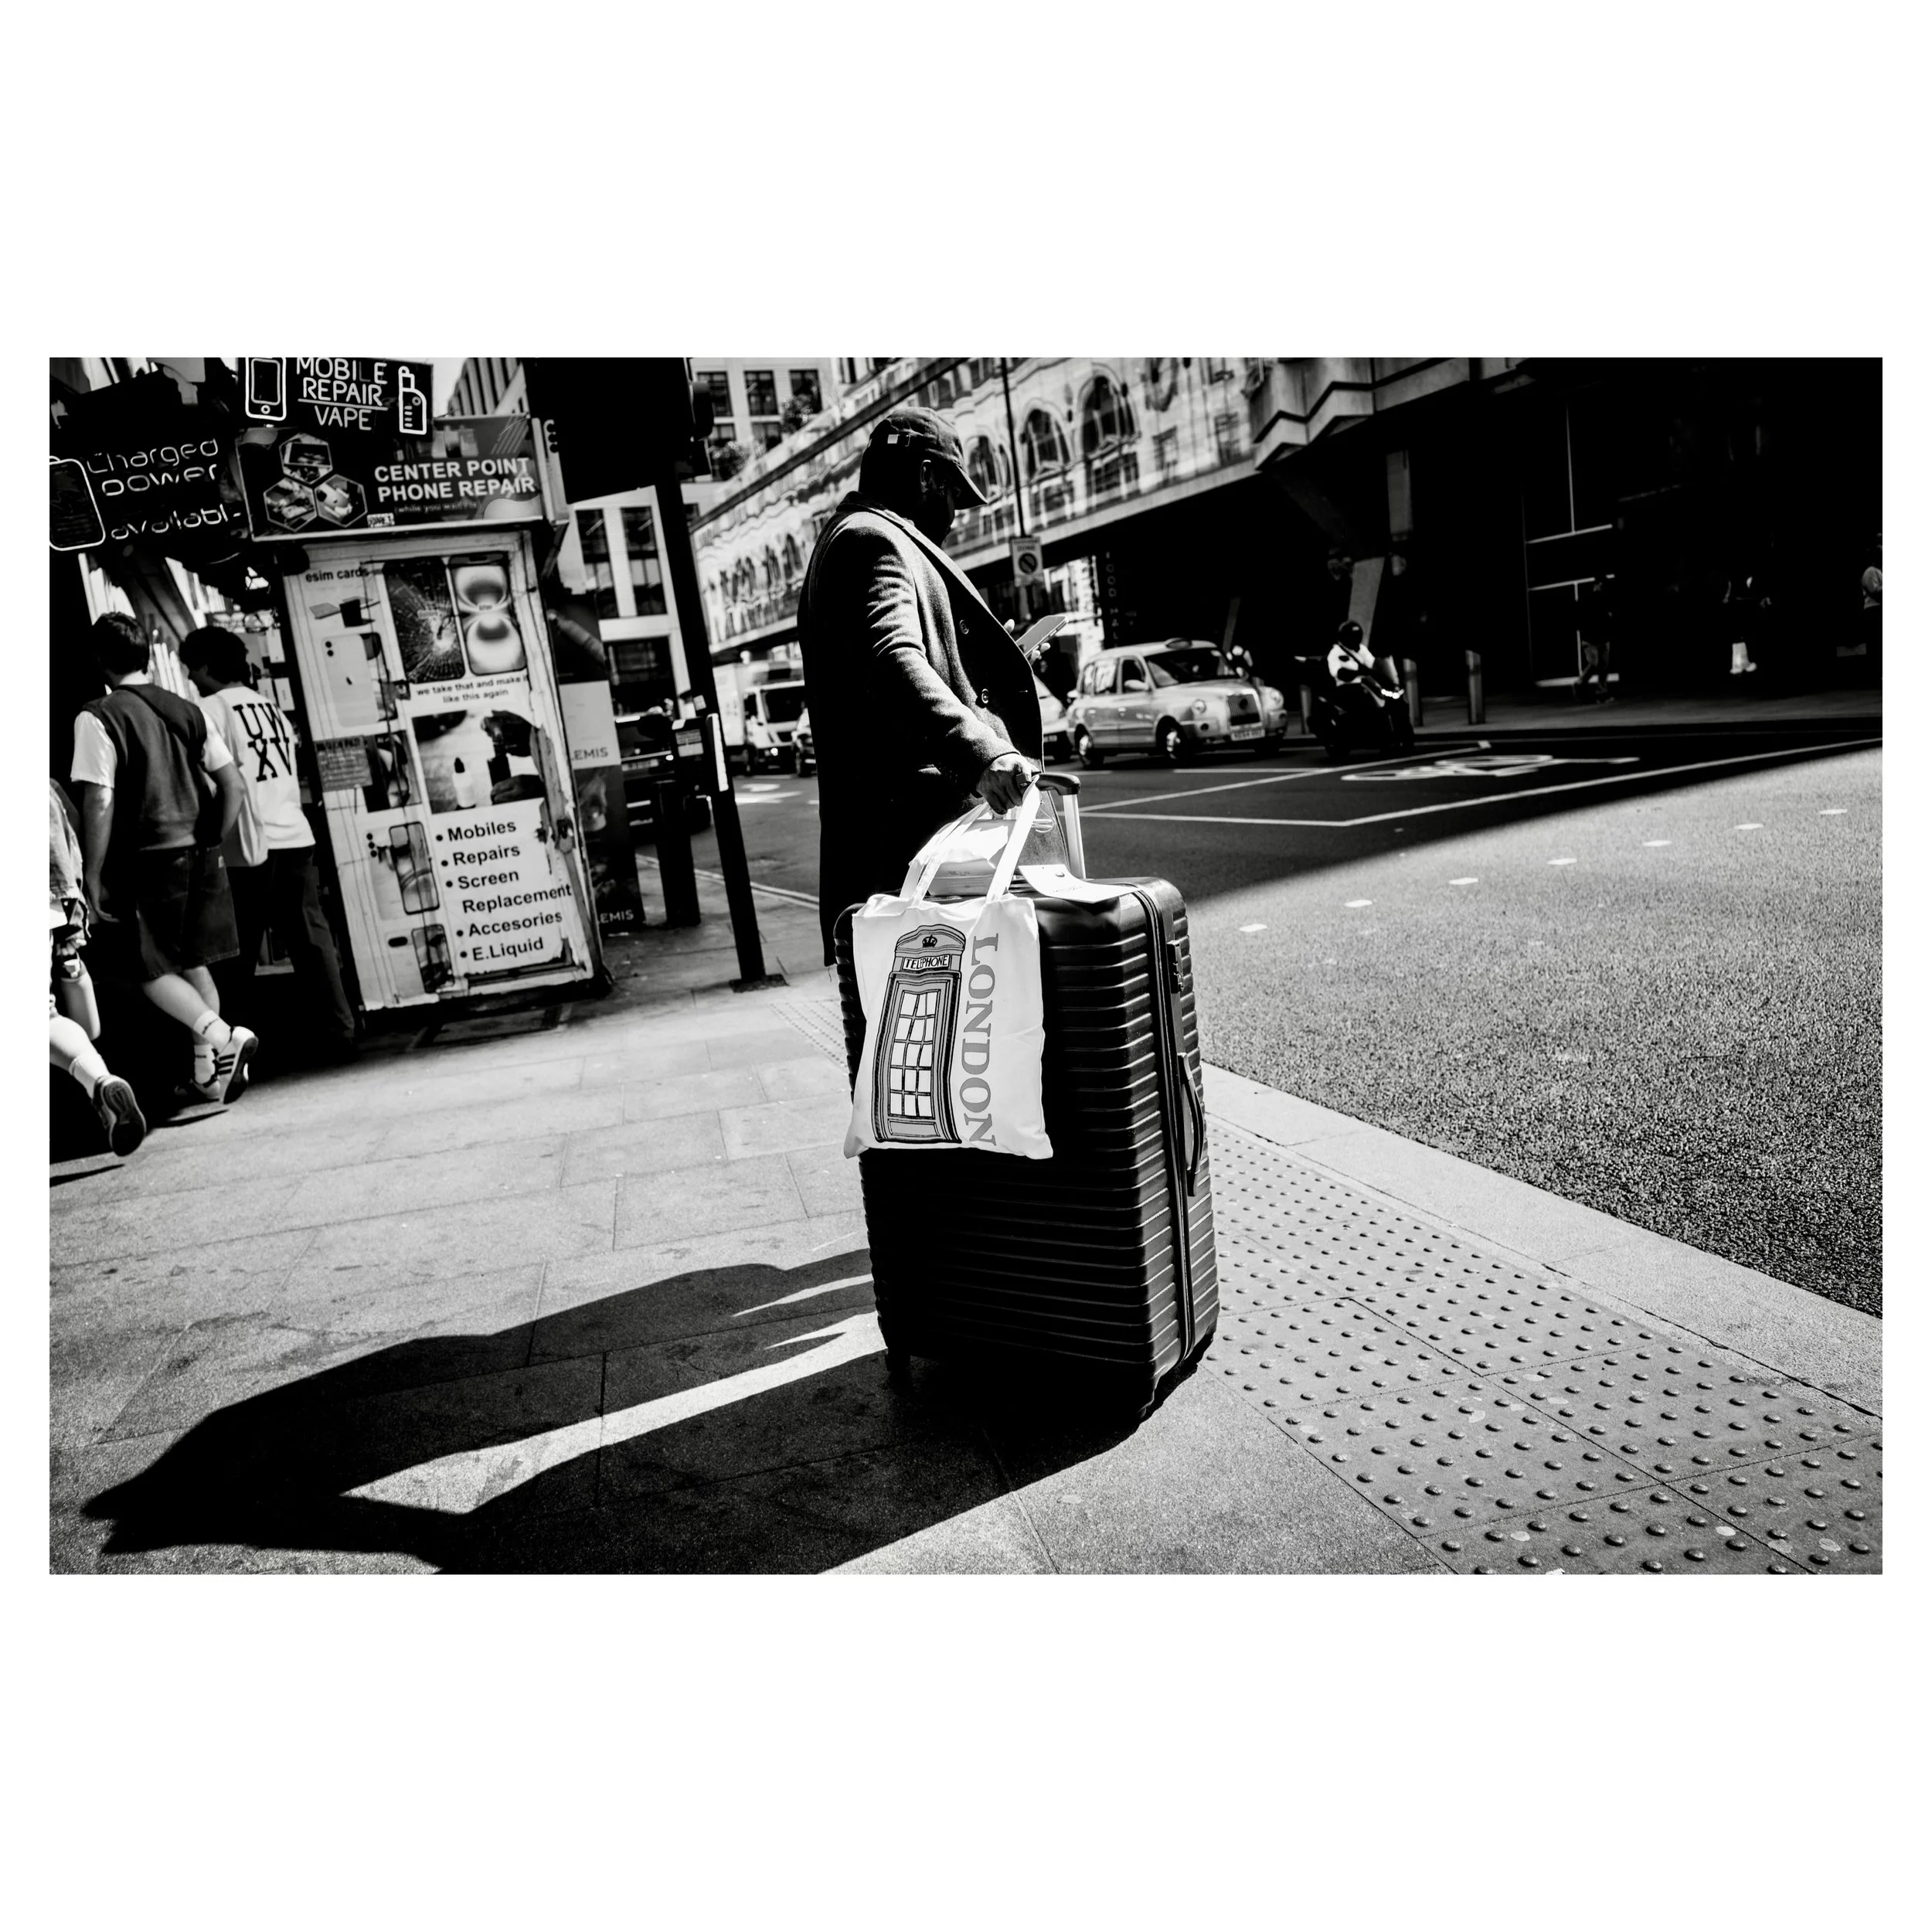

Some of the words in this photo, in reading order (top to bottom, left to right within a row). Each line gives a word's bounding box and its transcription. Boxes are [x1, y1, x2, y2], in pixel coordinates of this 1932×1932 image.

[296, 358, 388, 385] MOBILE
[303, 377, 383, 406] REPAIR
[314, 405, 372, 431] VAPE
[374, 461, 463, 482] CENTER
[467, 457, 529, 477] POINT
[378, 482, 454, 502] PHONE
[458, 477, 536, 498] REPAIR
[111, 503, 241, 540] availabl
[305, 570, 334, 583] esim
[443, 695, 460, 703] like
[462, 692, 480, 701] this
[483, 689, 509, 699] again
[455, 682, 473, 691] that
[496, 677, 521, 685] make
[447, 821, 517, 842] Mobiles
[453, 845, 521, 866] Repairs
[457, 871, 519, 889] Screen
[462, 884, 573, 913] Replacement
[468, 912, 563, 938] Accesories
[471, 937, 544, 961] E.Liquid
[905, 955, 948, 970] TELEPHONE
[960, 933, 999, 1147] LONDON
